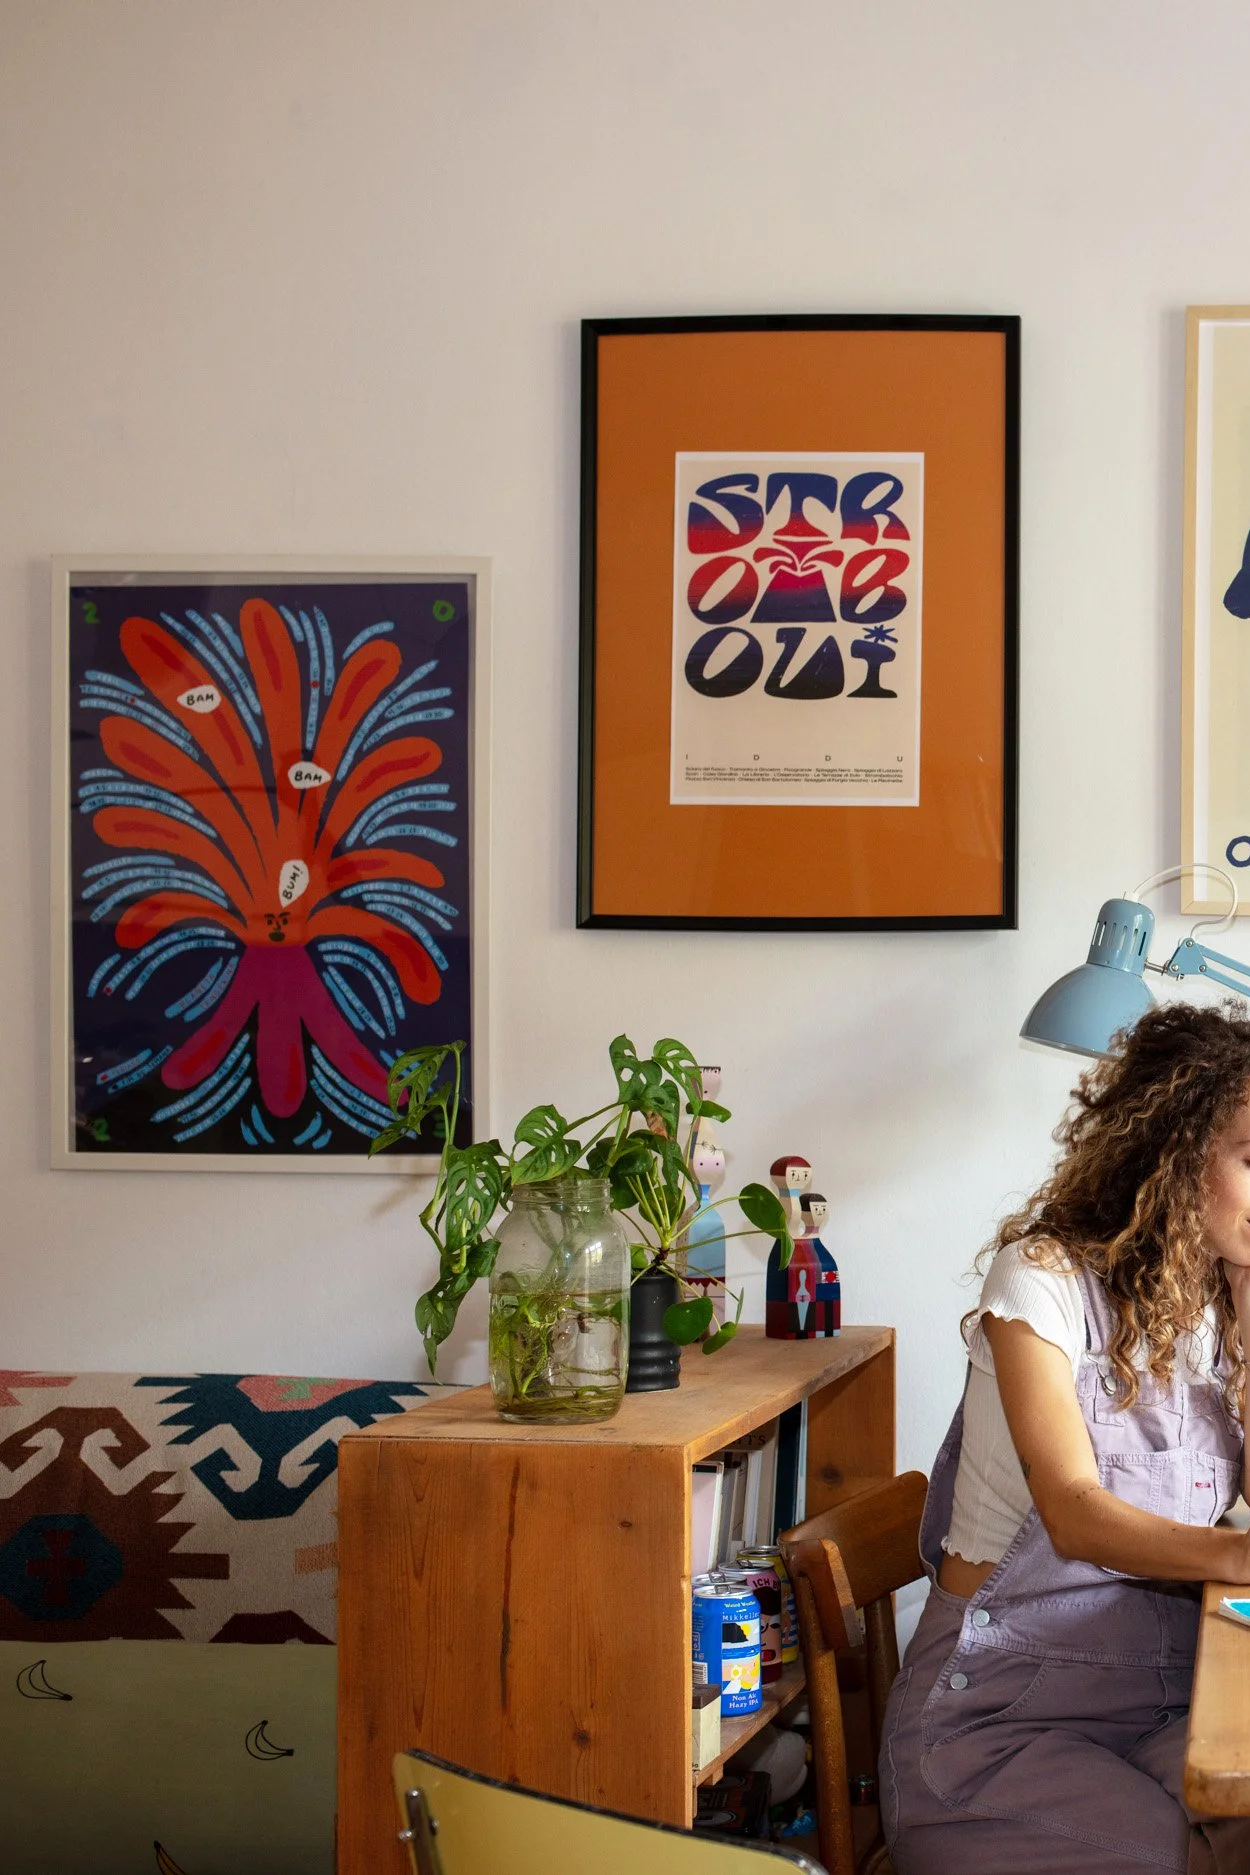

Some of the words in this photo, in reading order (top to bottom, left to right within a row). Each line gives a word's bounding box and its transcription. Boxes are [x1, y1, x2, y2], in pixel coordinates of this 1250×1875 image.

[82, 601, 99, 624] 2
[187, 693, 214, 705] BAM
[294, 770, 322, 783] BAM
[282, 864, 303, 900] BUM!
[752, 1578, 770, 1588] ICH
